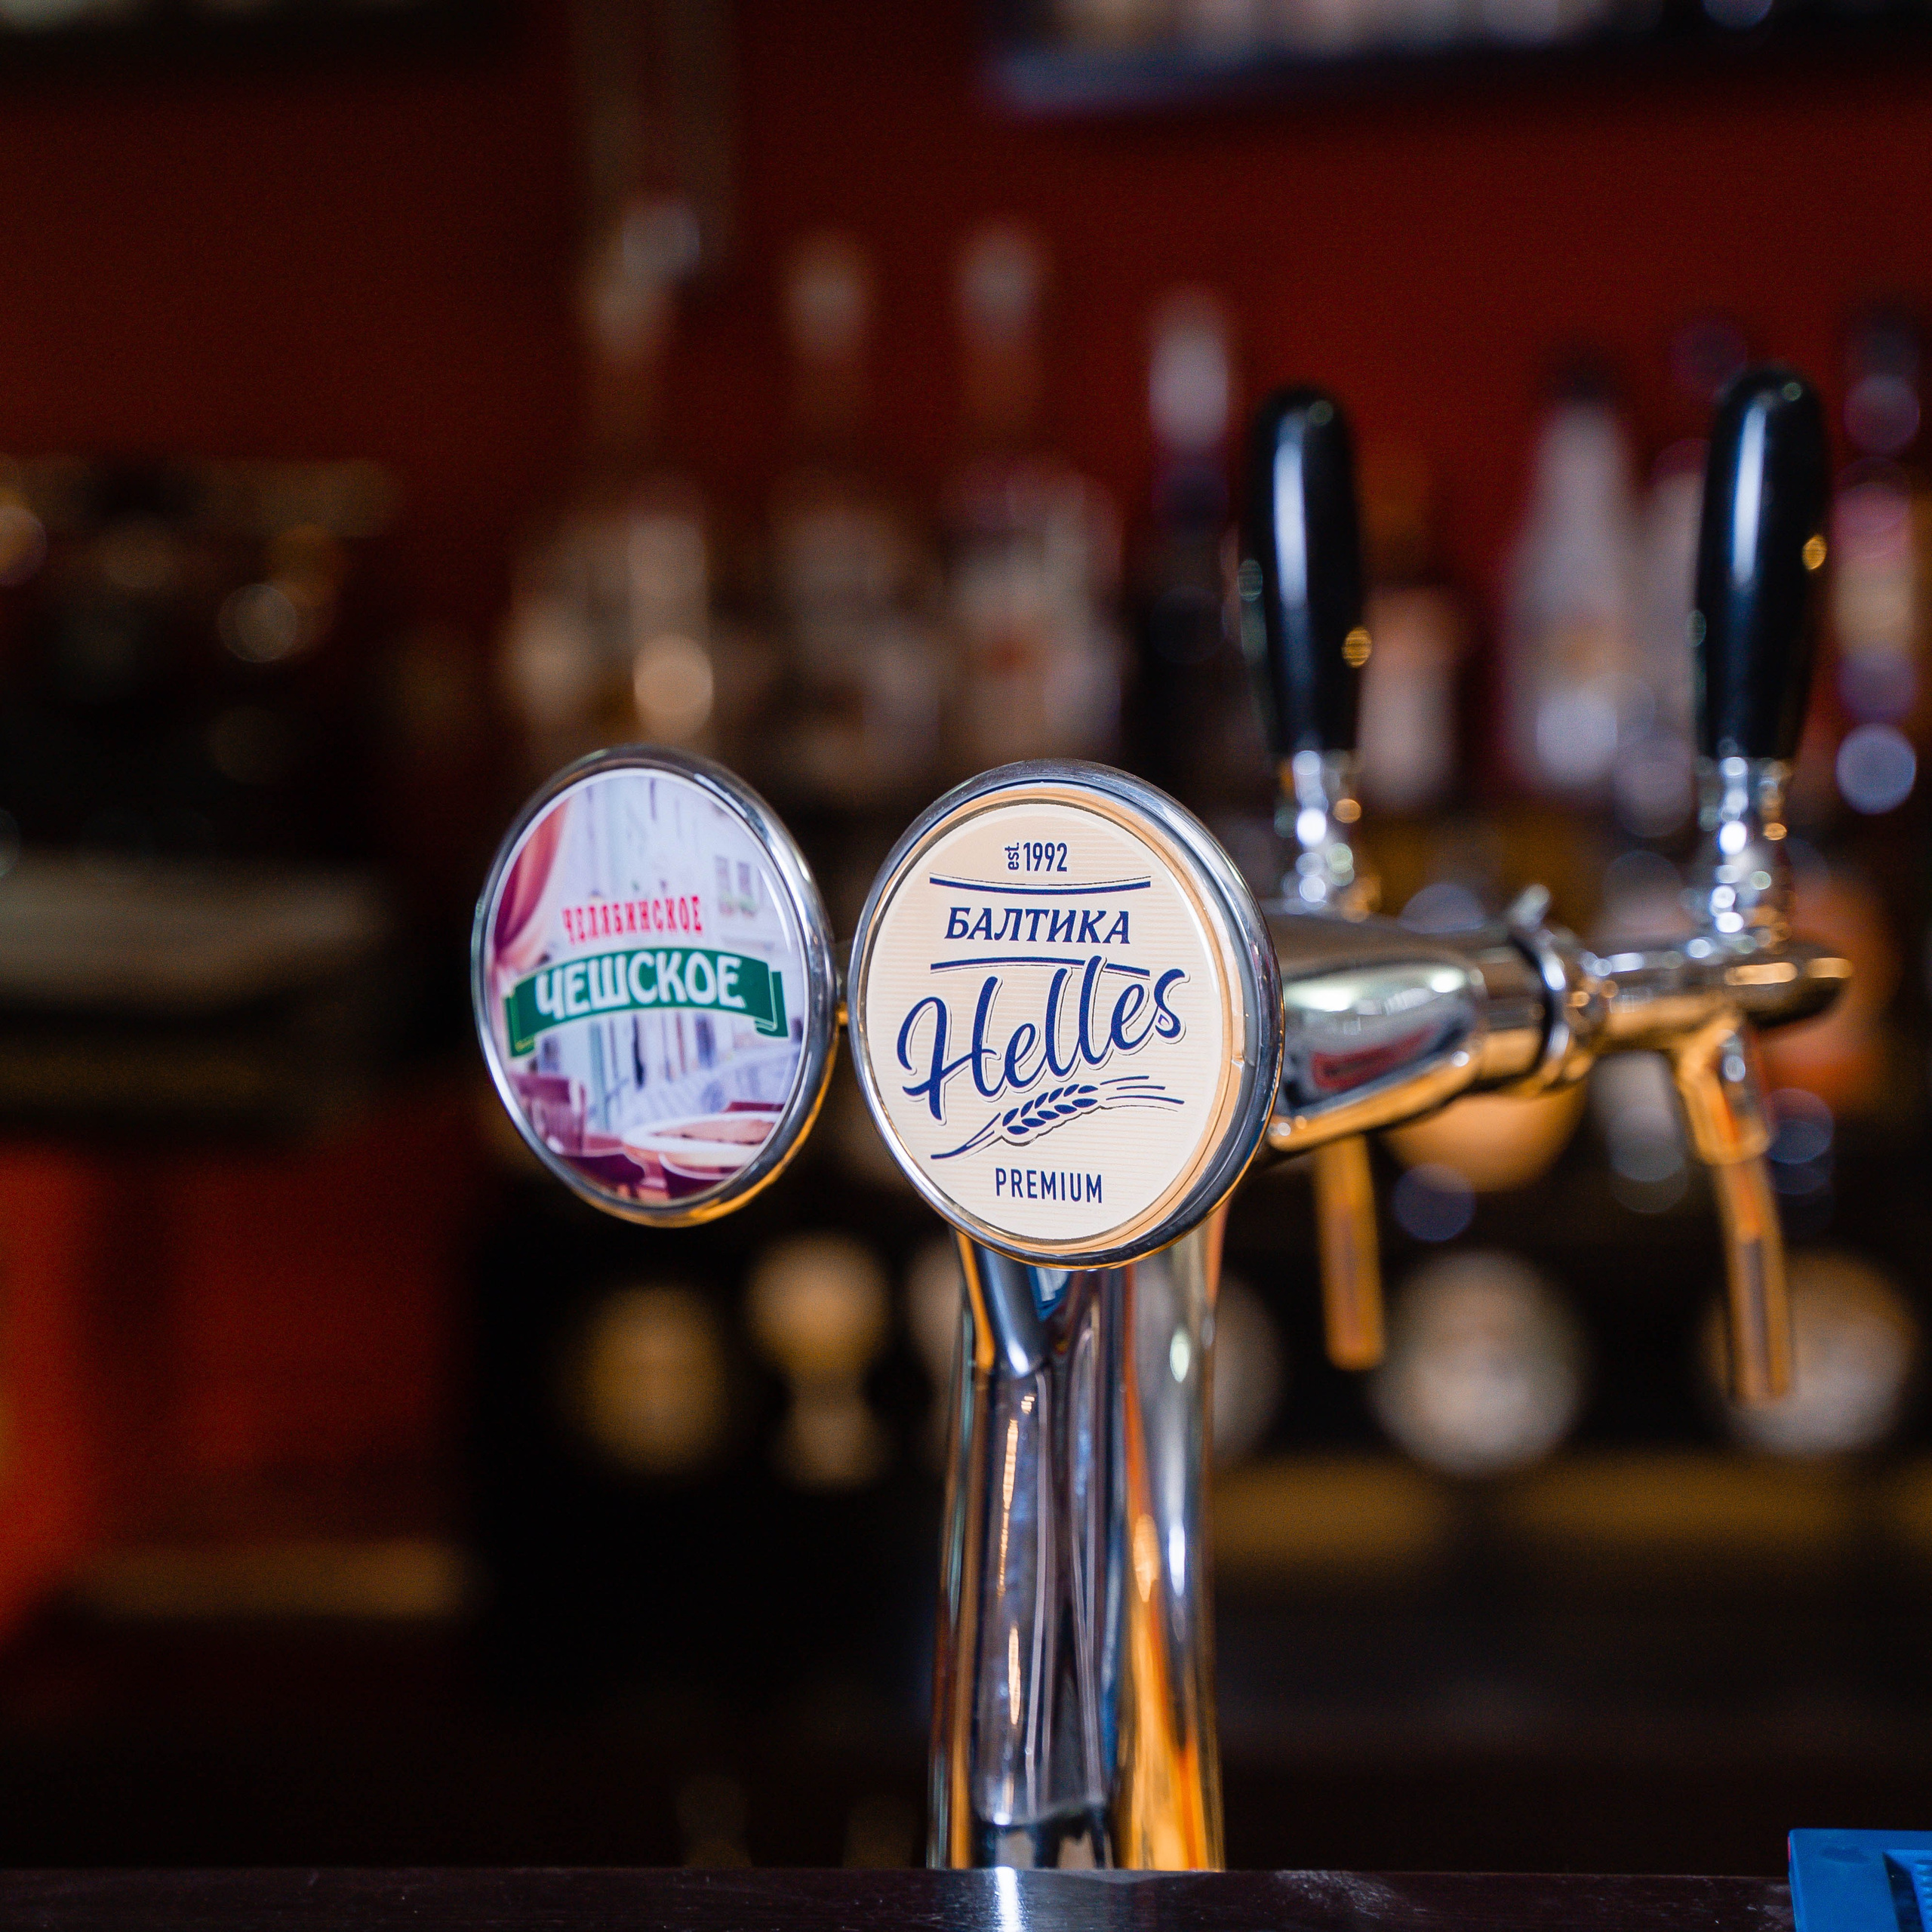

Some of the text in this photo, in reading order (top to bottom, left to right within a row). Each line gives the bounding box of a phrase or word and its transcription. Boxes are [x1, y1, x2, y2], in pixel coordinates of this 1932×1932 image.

[1023, 842, 1067, 872] 1992
[562, 895, 703, 945] ЧЕЛЯБИНСКОЕ
[944, 907, 1131, 944] БАЛТИКА
[535, 951, 747, 1020] ЧЕШСКОЕ
[897, 955, 1184, 1121] Helles
[995, 1168, 1103, 1204] PREMIUM
